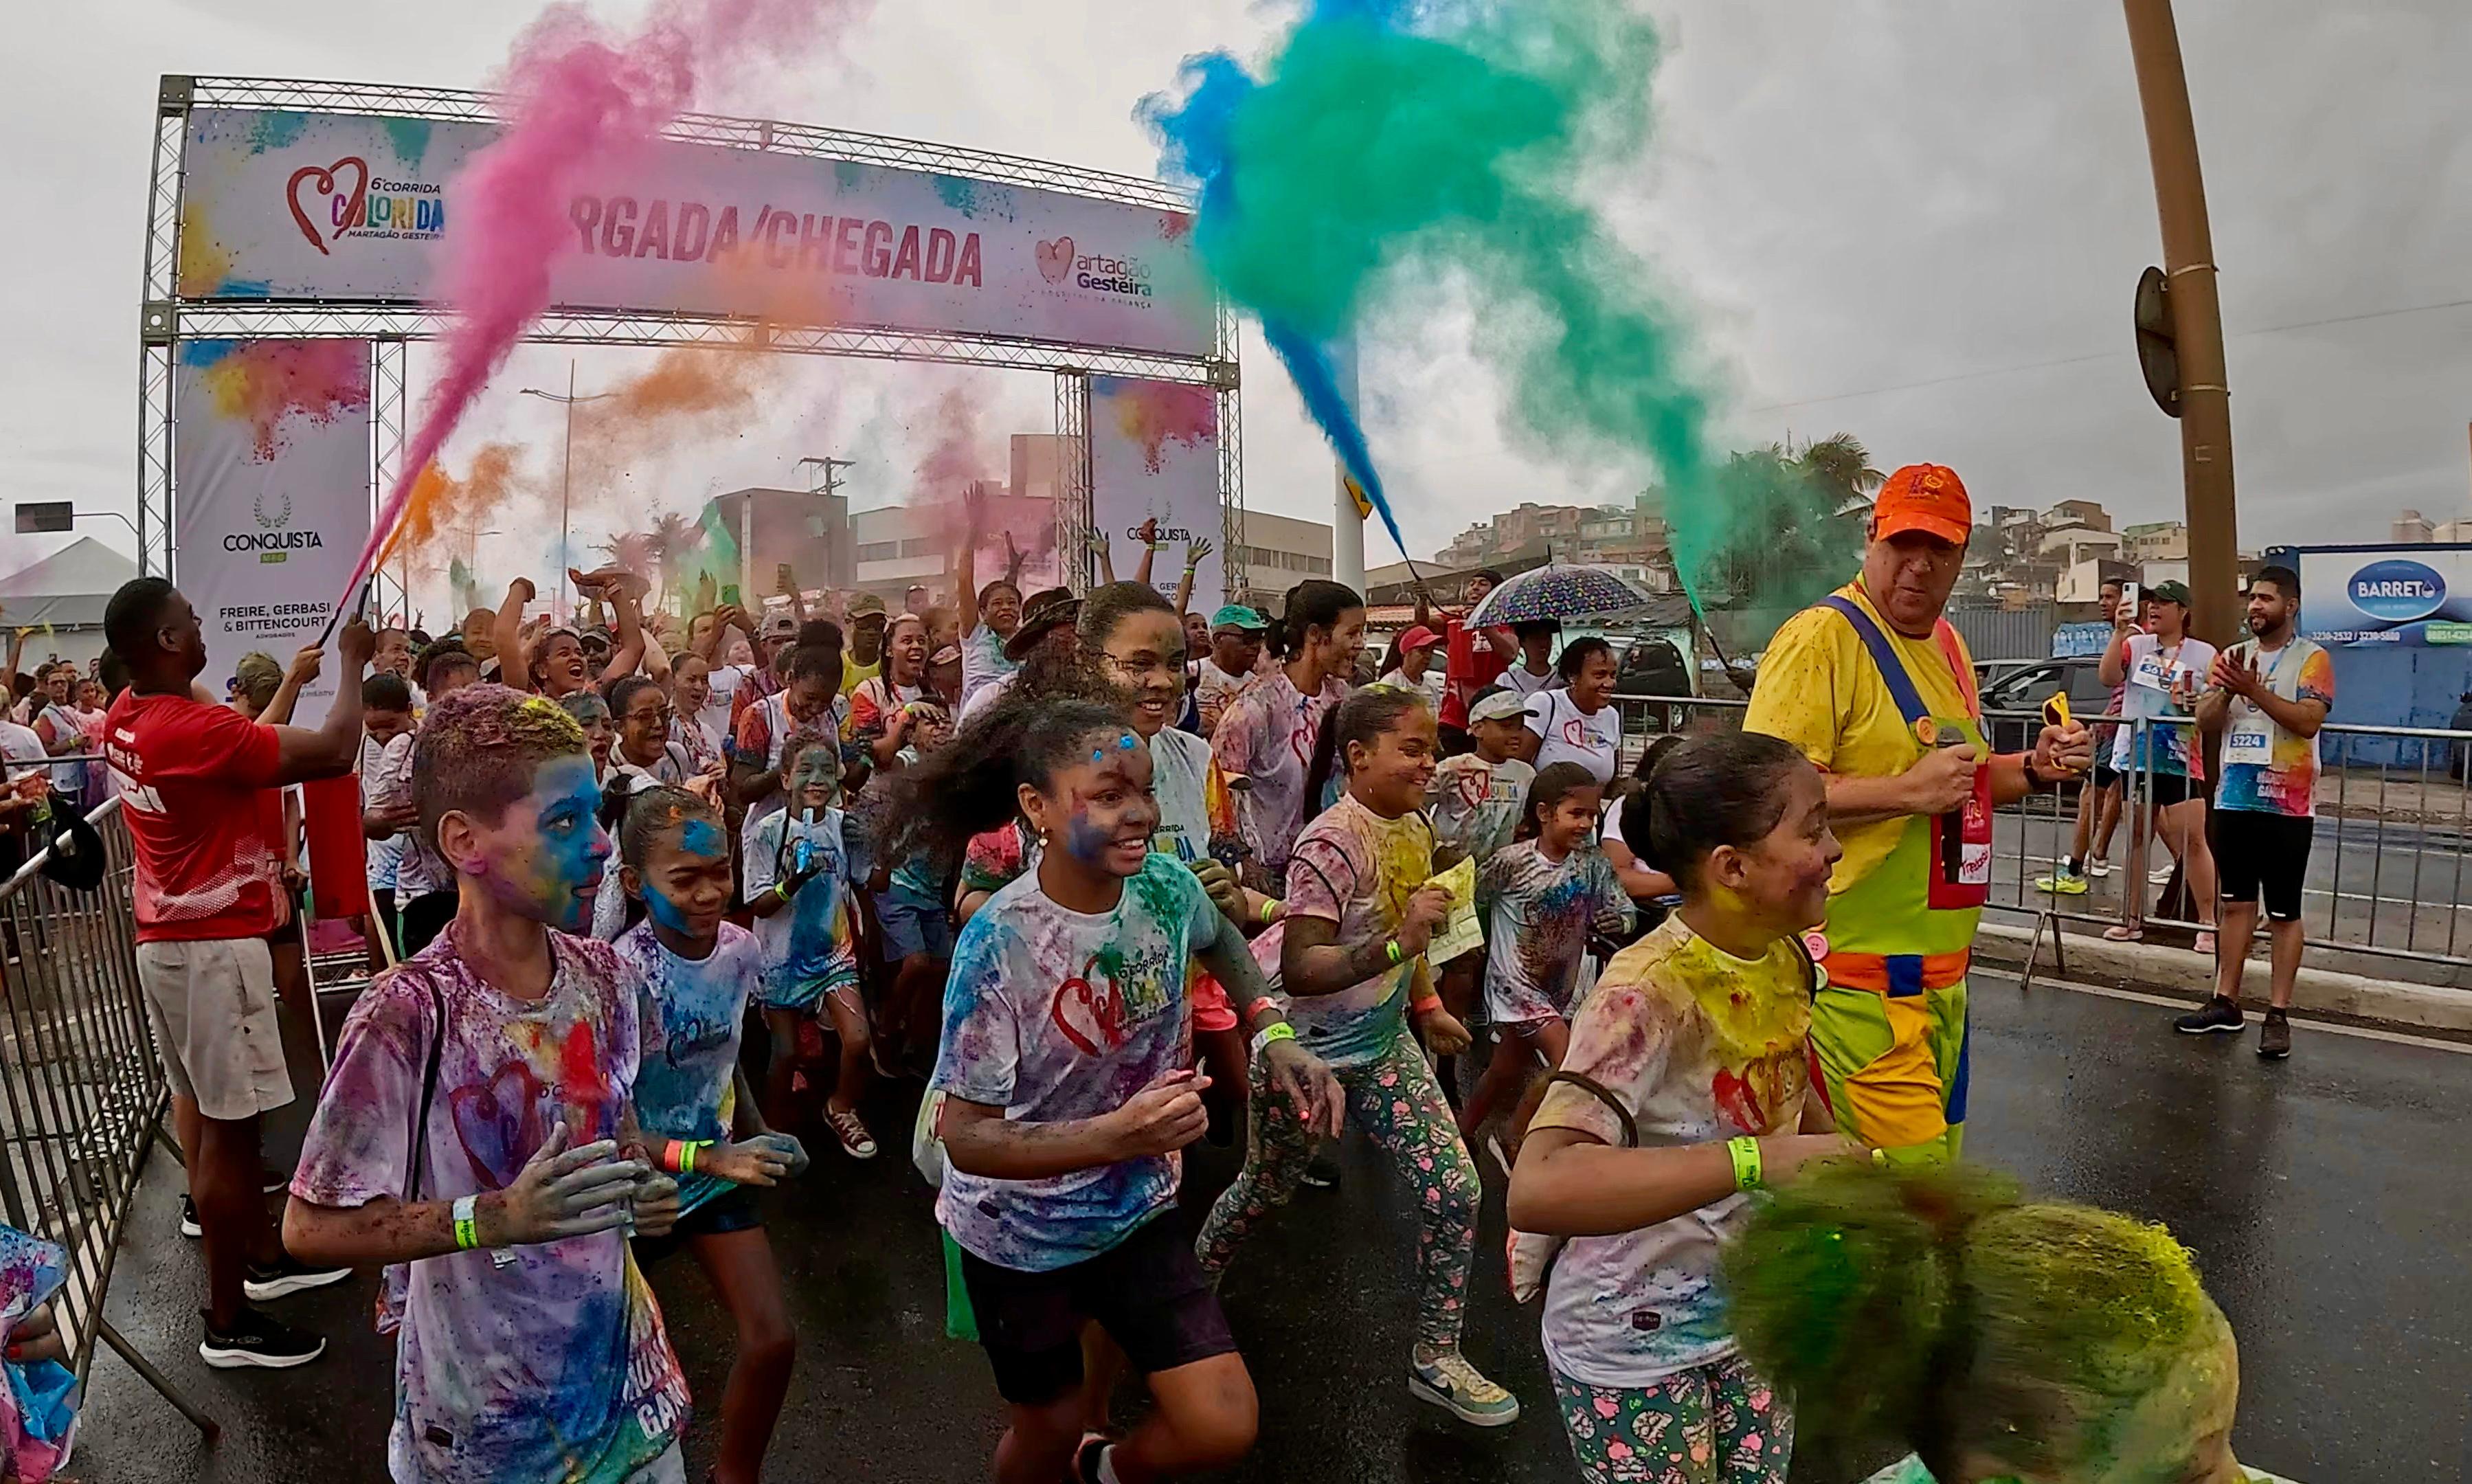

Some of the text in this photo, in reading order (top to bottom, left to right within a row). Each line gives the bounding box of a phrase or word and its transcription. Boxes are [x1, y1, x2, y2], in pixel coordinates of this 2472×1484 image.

[347, 229, 399, 239] MARTAGÃO
[1077, 272, 1151, 297] Gesteira
[223, 531, 323, 552] CONQUISTA
[2357, 579, 2436, 598] BARRETO
[220, 602, 330, 618] FREIRE, GERBASI
[224, 616, 328, 632] & BITTENCOURT
[2230, 735, 2260, 747] 5224
[1152, 824, 1185, 834] ORRIDA
